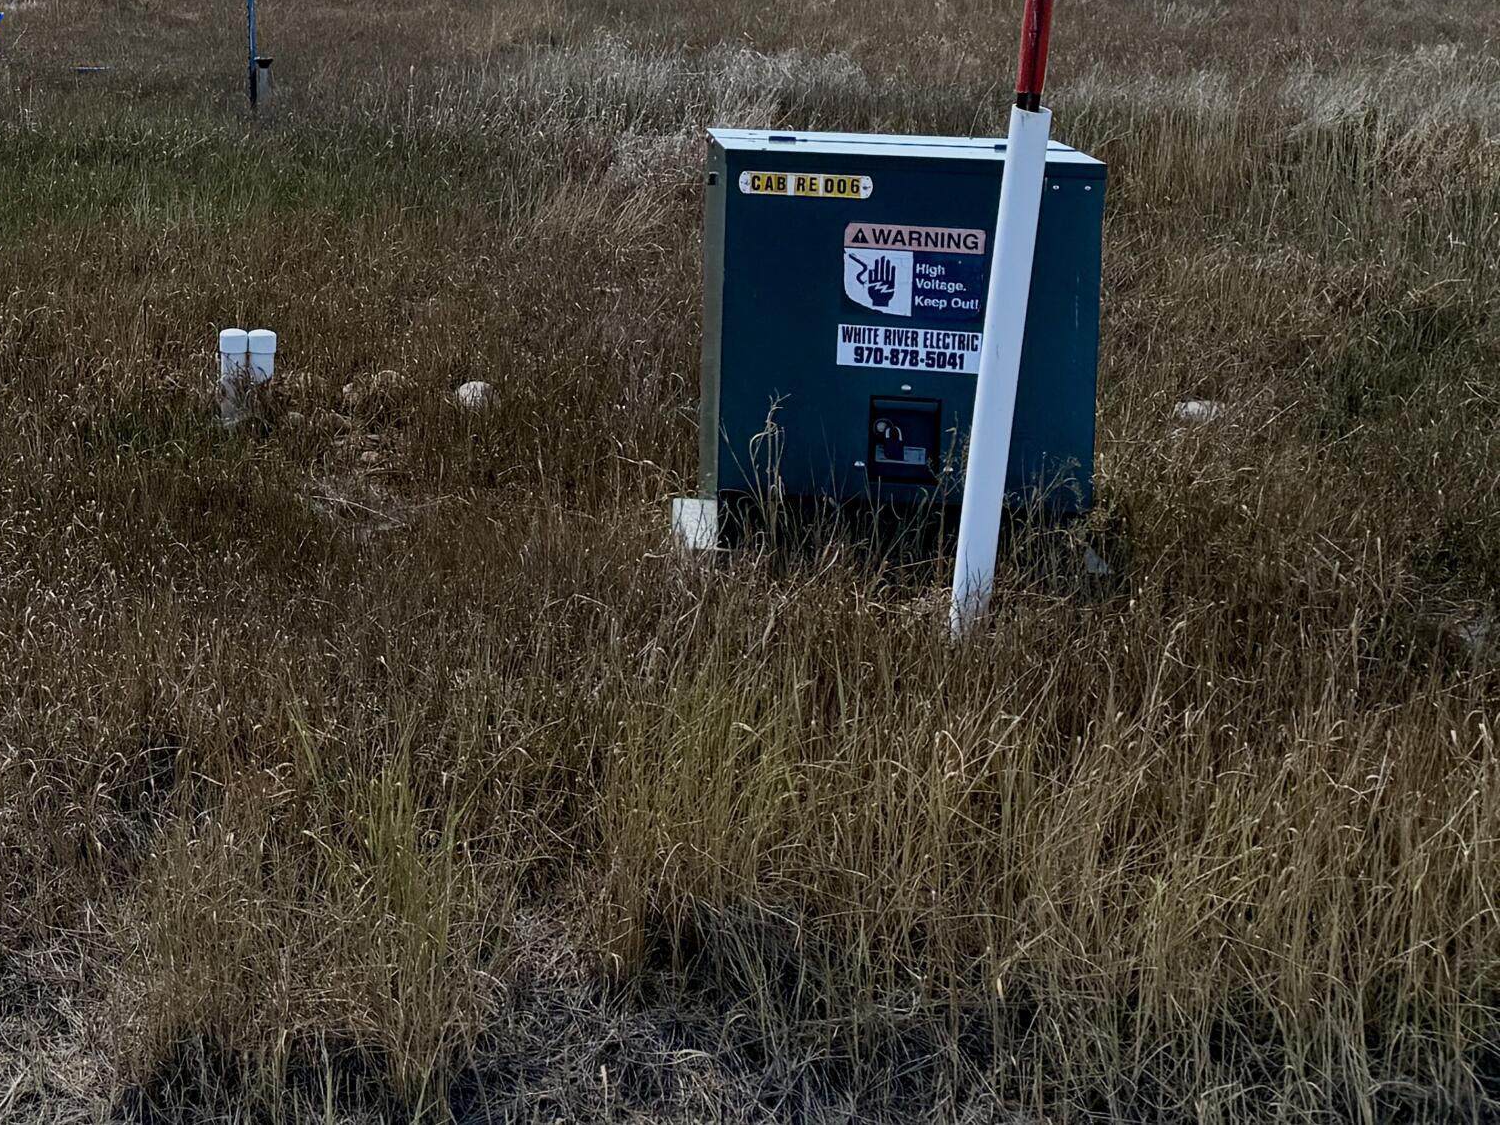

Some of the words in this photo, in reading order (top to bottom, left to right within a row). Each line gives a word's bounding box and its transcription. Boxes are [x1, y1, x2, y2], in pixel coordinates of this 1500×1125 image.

[751, 175, 787, 191] CAB
[796, 176, 818, 192] RE
[824, 178, 860, 194] 006
[872, 228, 979, 251] WARNING
[915, 263, 946, 278] High
[915, 278, 967, 293] Voltage.
[914, 296, 948, 310] Keep
[951, 298, 979, 310] Out!
[841, 325, 880, 346] WHITE
[883, 328, 919, 348] RIVER
[923, 331, 979, 352] ELECTRIC
[853, 346, 965, 371] 970-878-5041
